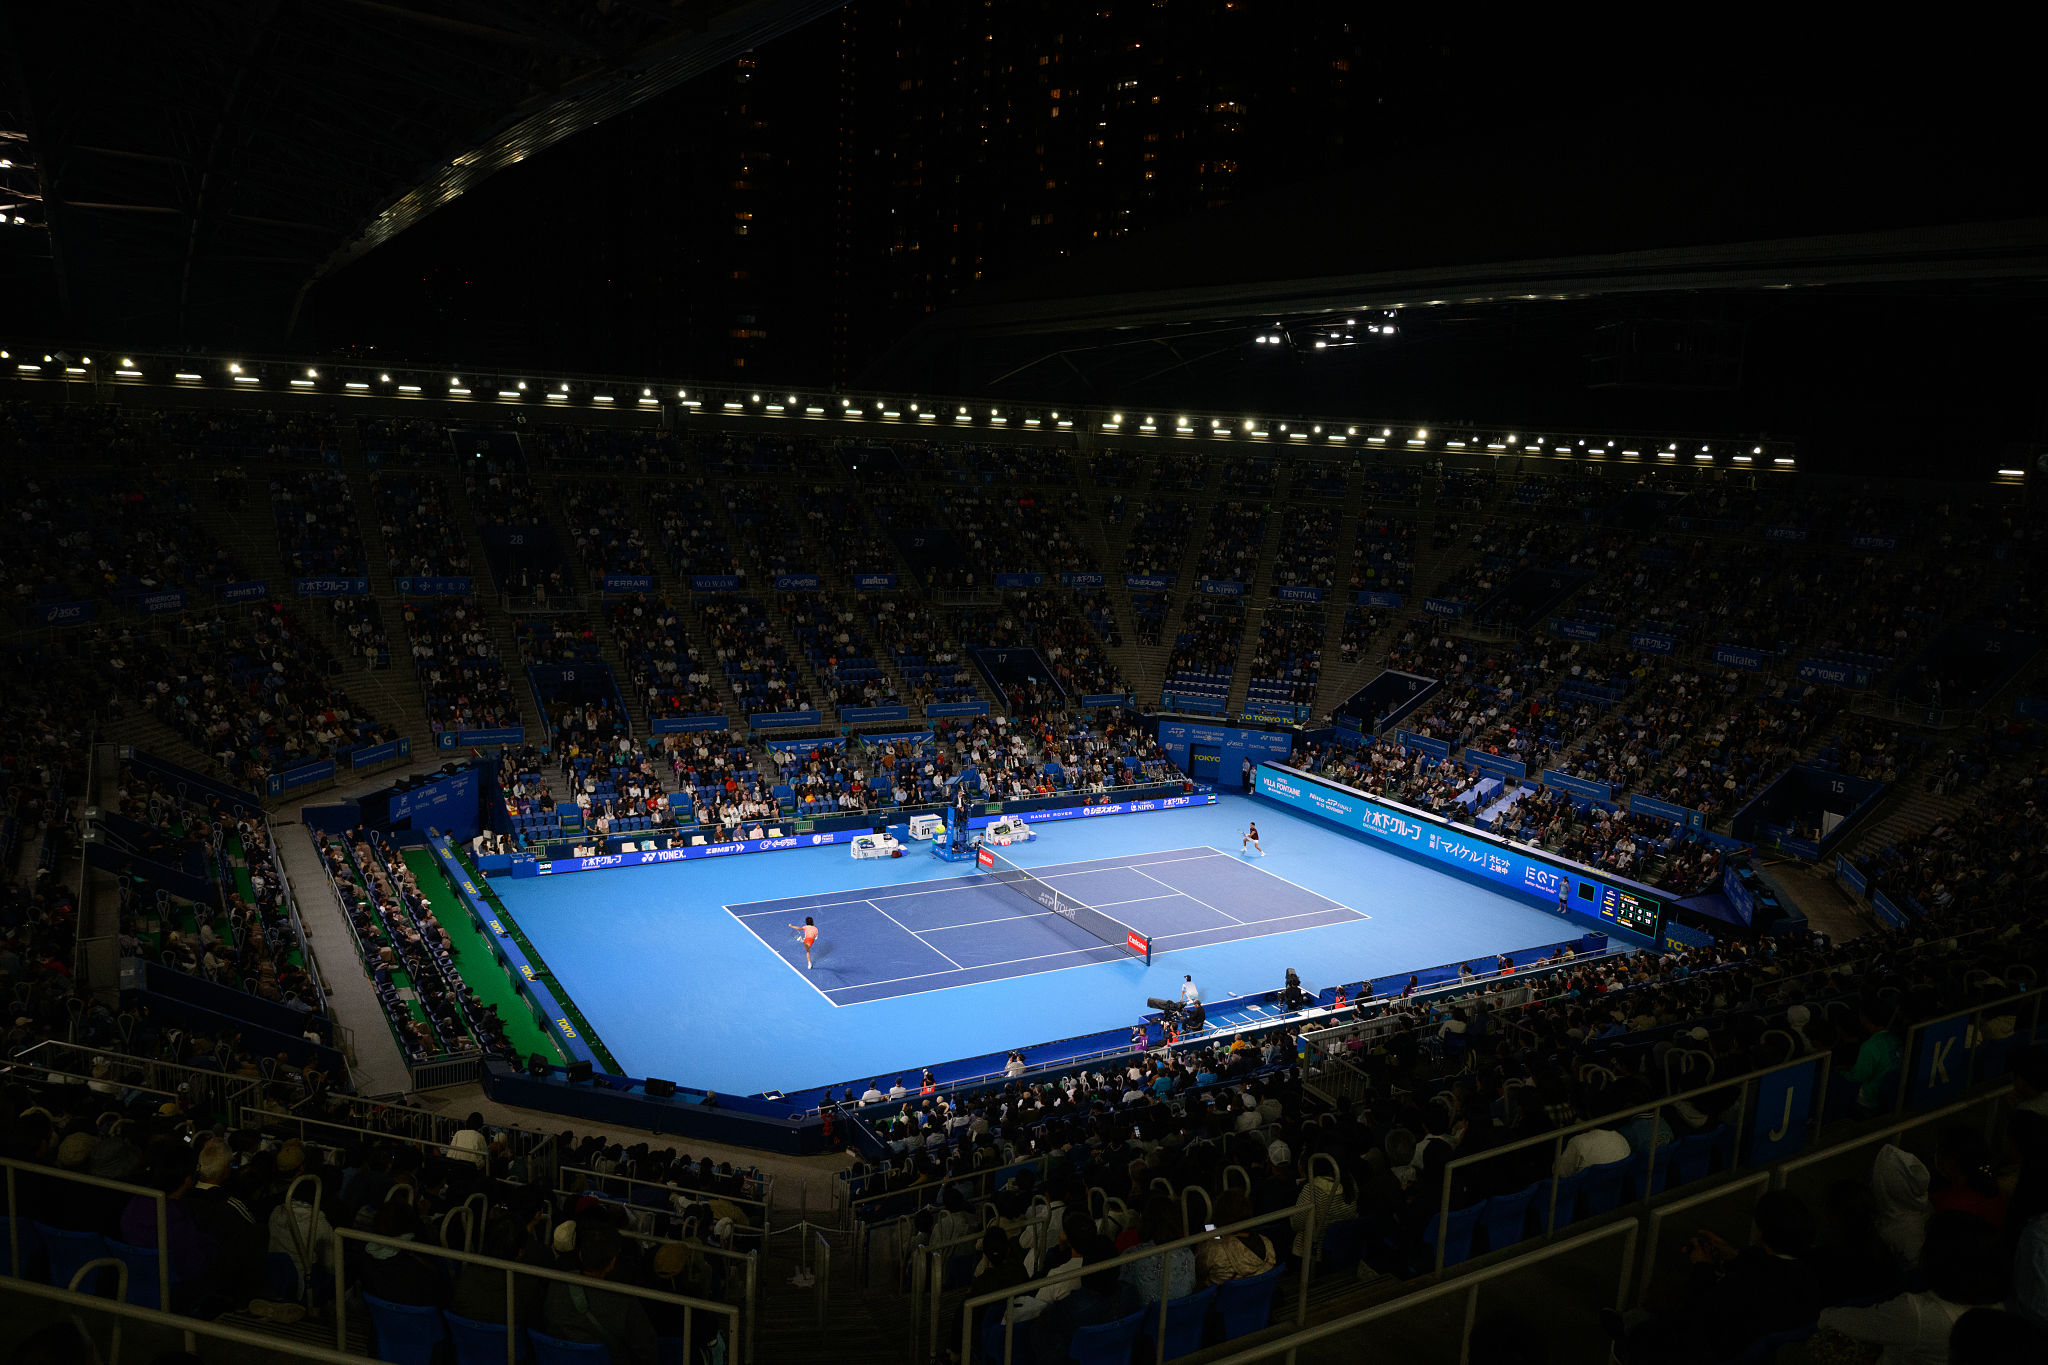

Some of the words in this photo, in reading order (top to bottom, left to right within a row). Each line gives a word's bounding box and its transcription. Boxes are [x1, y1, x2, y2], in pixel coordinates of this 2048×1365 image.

[510, 535, 523, 545] 28
[307, 581, 349, 592] 木下グループ
[358, 582, 365, 590] P
[401, 581, 410, 591] O
[696, 580, 734, 588] WOWOW
[145, 594, 181, 606] AMERICAN
[1282, 589, 1318, 600] TENTIAL
[1425, 601, 1454, 615] Nitto
[1984, 640, 2001, 654] 25
[998, 654, 1007, 664] 17
[1717, 651, 1759, 667] Emirates
[561, 671, 575, 682] 18
[1818, 667, 1846, 683] YONEX
[1408, 681, 1417, 692] 16
[401, 742, 408, 751] H
[444, 736, 452, 746] G
[1194, 754, 1221, 763] TOKYO
[273, 781, 280, 792] H
[1263, 778, 1276, 788] VILLA
[1276, 783, 1301, 797] FONTAINE
[1832, 780, 1845, 793] 15
[1138, 803, 1155, 811] NIPPO
[1168, 796, 1190, 806] 木下グループ
[1309, 793, 1325, 803] Nitto
[1325, 798, 1338, 807] ATP
[1338, 803, 1353, 813] FINALS
[1371, 811, 1422, 841] 木下グループ
[1693, 814, 1700, 826] E
[922, 826, 930, 836] in
[1436, 835, 1488, 868] 『マイケル』
[588, 855, 622, 866] 木下グループ
[1489, 854, 1511, 868] 大ヒット
[1488, 862, 1509, 876] 上映中
[1525, 865, 1559, 887] EQT
[462, 880, 477, 894] TOKYO
[1038, 891, 1054, 907] ATP
[1056, 900, 1076, 921] TOUR
[489, 919, 505, 935] TOKYO
[1128, 934, 1147, 952] Emirates
[556, 1017, 577, 1039] TOKYO
[1928, 1036, 1958, 1089] K
[1768, 1086, 1794, 1143] J
